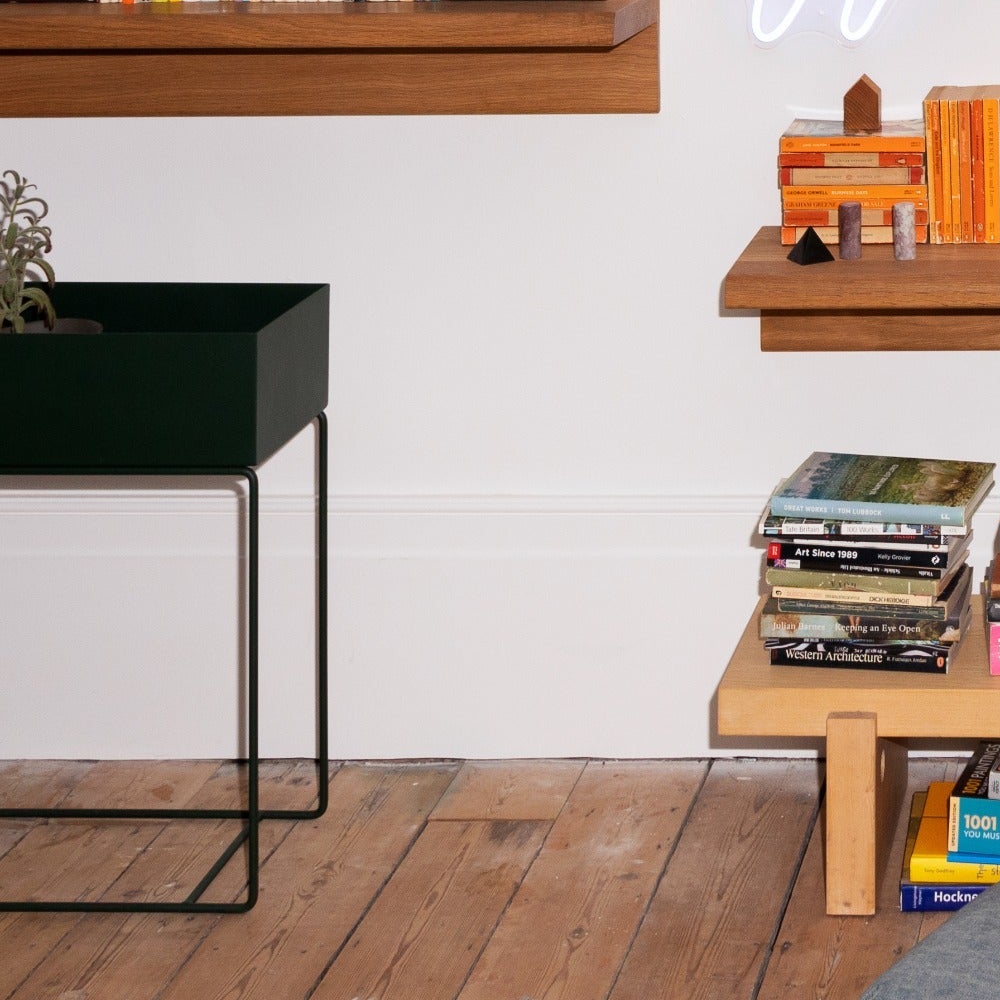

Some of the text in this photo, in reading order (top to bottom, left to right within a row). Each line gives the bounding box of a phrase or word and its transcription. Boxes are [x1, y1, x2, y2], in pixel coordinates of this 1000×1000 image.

[783, 504, 882, 516] GREAT WORKS TOM LUBBOCK
[785, 525, 799, 533] Tate
[800, 525, 820, 533] Britain
[794, 548, 810, 557] Art
[811, 548, 836, 558] Since
[837, 549, 858, 559] 1989
[883, 597, 910, 605] HEBDIGE
[772, 622, 797, 631] Julian
[797, 622, 826, 631] Barnes
[834, 623, 868, 634] Keeping
[881, 624, 897, 634] Eye
[898, 625, 921, 634] Open
[785, 649, 824, 660] Western
[825, 651, 883, 663] Architecture
[961, 775, 979, 795] 1001
[963, 813, 998, 831] 1001
[963, 829, 981, 839] YOU
